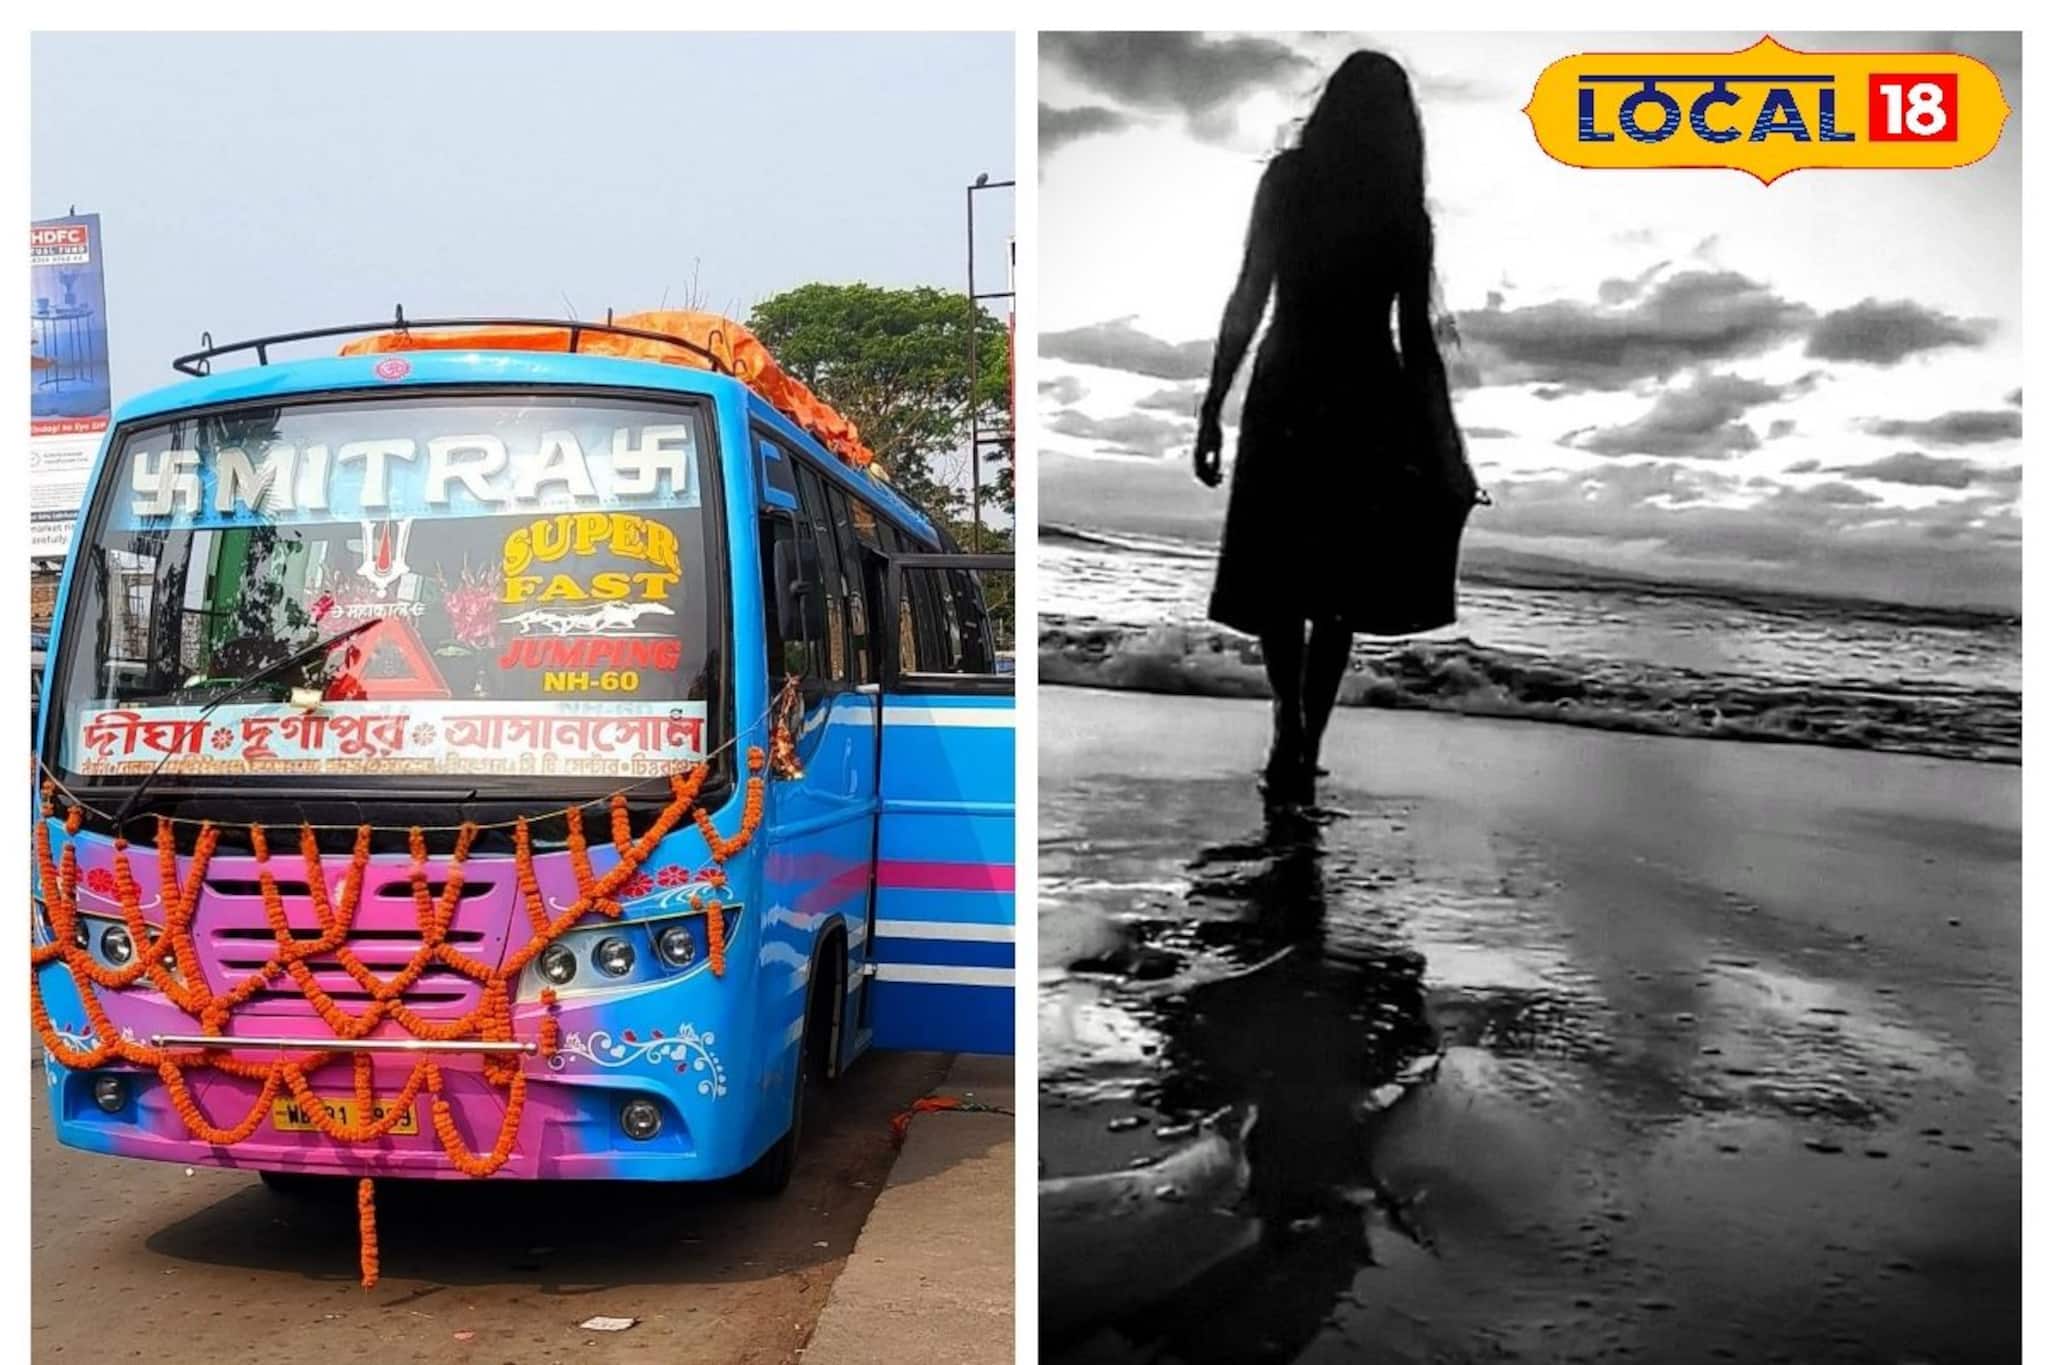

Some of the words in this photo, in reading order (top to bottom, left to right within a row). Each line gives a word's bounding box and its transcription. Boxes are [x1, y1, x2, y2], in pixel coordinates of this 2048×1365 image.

[32, 230, 80, 244] HDFC
[214, 430, 600, 513] MITRA
[503, 513, 682, 576] SUPER
[501, 572, 679, 604] FAST
[344, 602, 411, 620] महाकाल
[499, 638, 682, 671] JUMPING
[542, 671, 639, 692] NH-60
[84, 711, 211, 756] দীঘা
[442, 715, 705, 752] আসানসোল
